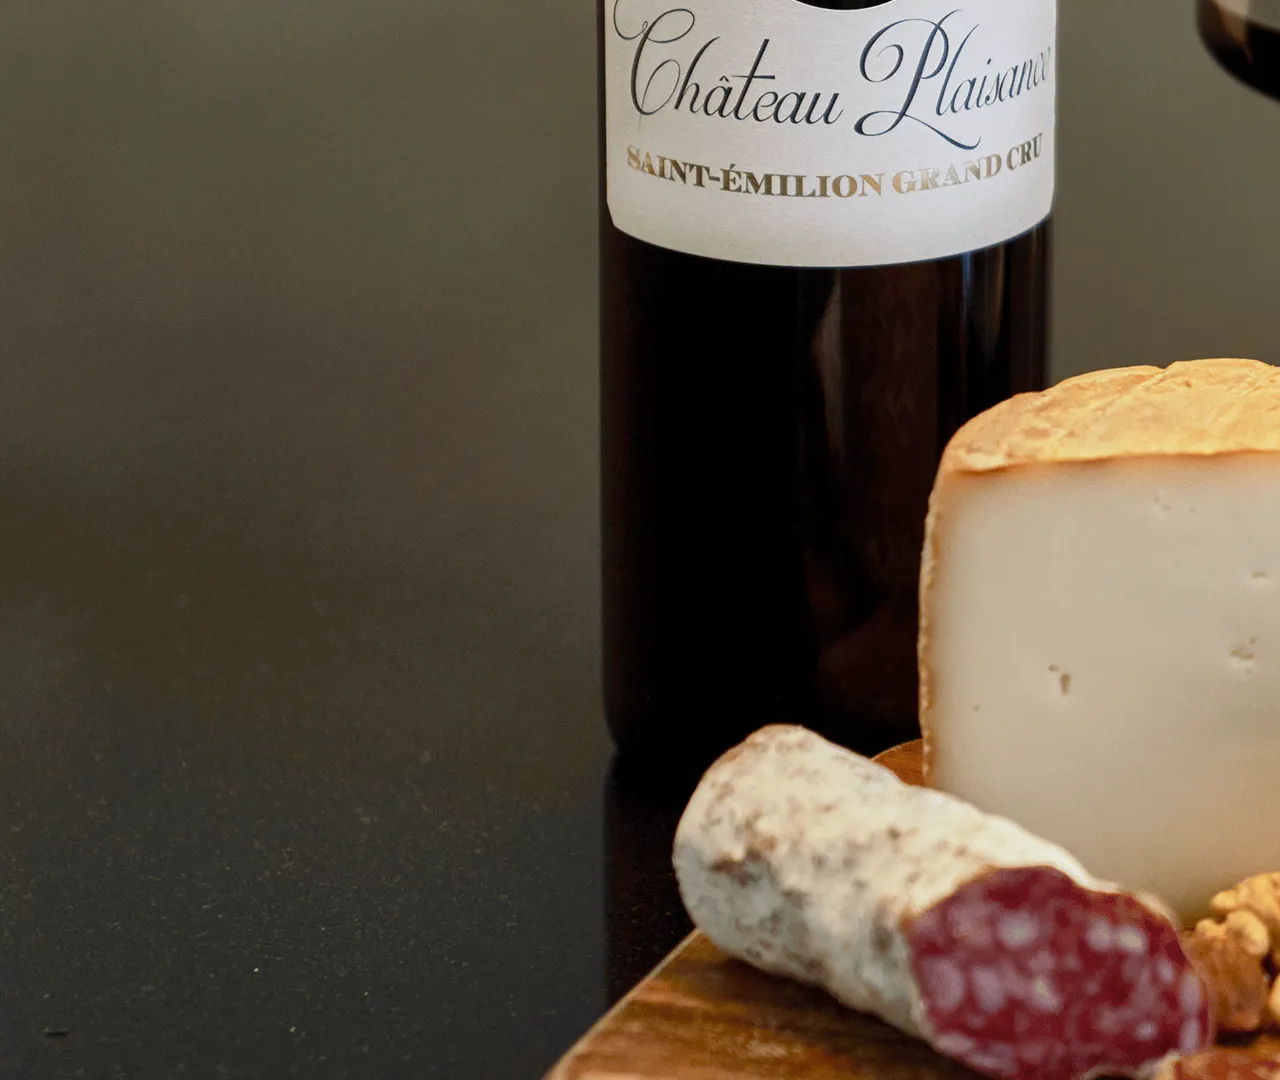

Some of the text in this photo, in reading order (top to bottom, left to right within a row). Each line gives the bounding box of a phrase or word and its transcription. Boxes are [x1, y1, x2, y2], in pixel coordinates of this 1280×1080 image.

[853, 9, 1051, 150] Plaisance
[627, 132, 1044, 198] SAINT-ÉMILION GRAND CRU
